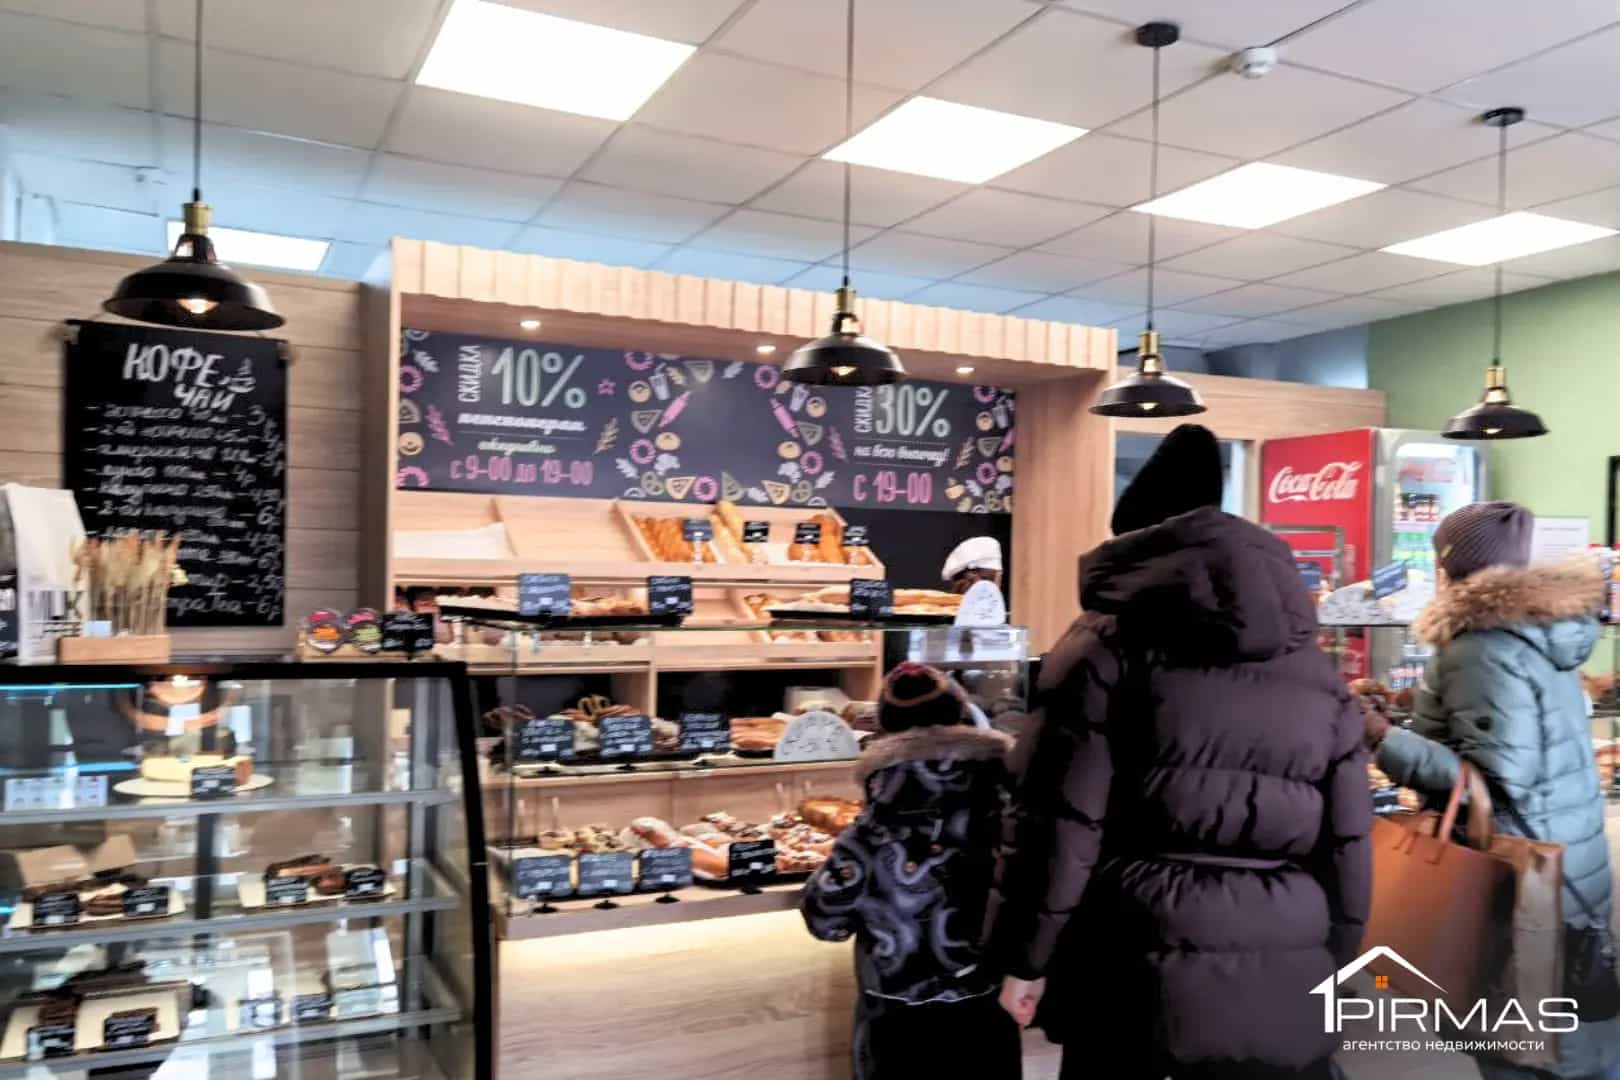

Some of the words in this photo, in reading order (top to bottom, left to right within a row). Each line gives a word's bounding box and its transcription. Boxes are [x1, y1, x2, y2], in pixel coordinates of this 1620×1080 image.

[122, 343, 224, 387] КОФЕ
[458, 345, 481, 402] СКИДКА
[491, 347, 587, 409] 10%
[875, 384, 950, 437] 30%
[465, 455, 512, 483] 9-00
[540, 459, 593, 486] 19-00
[873, 471, 932, 503] 19-00
